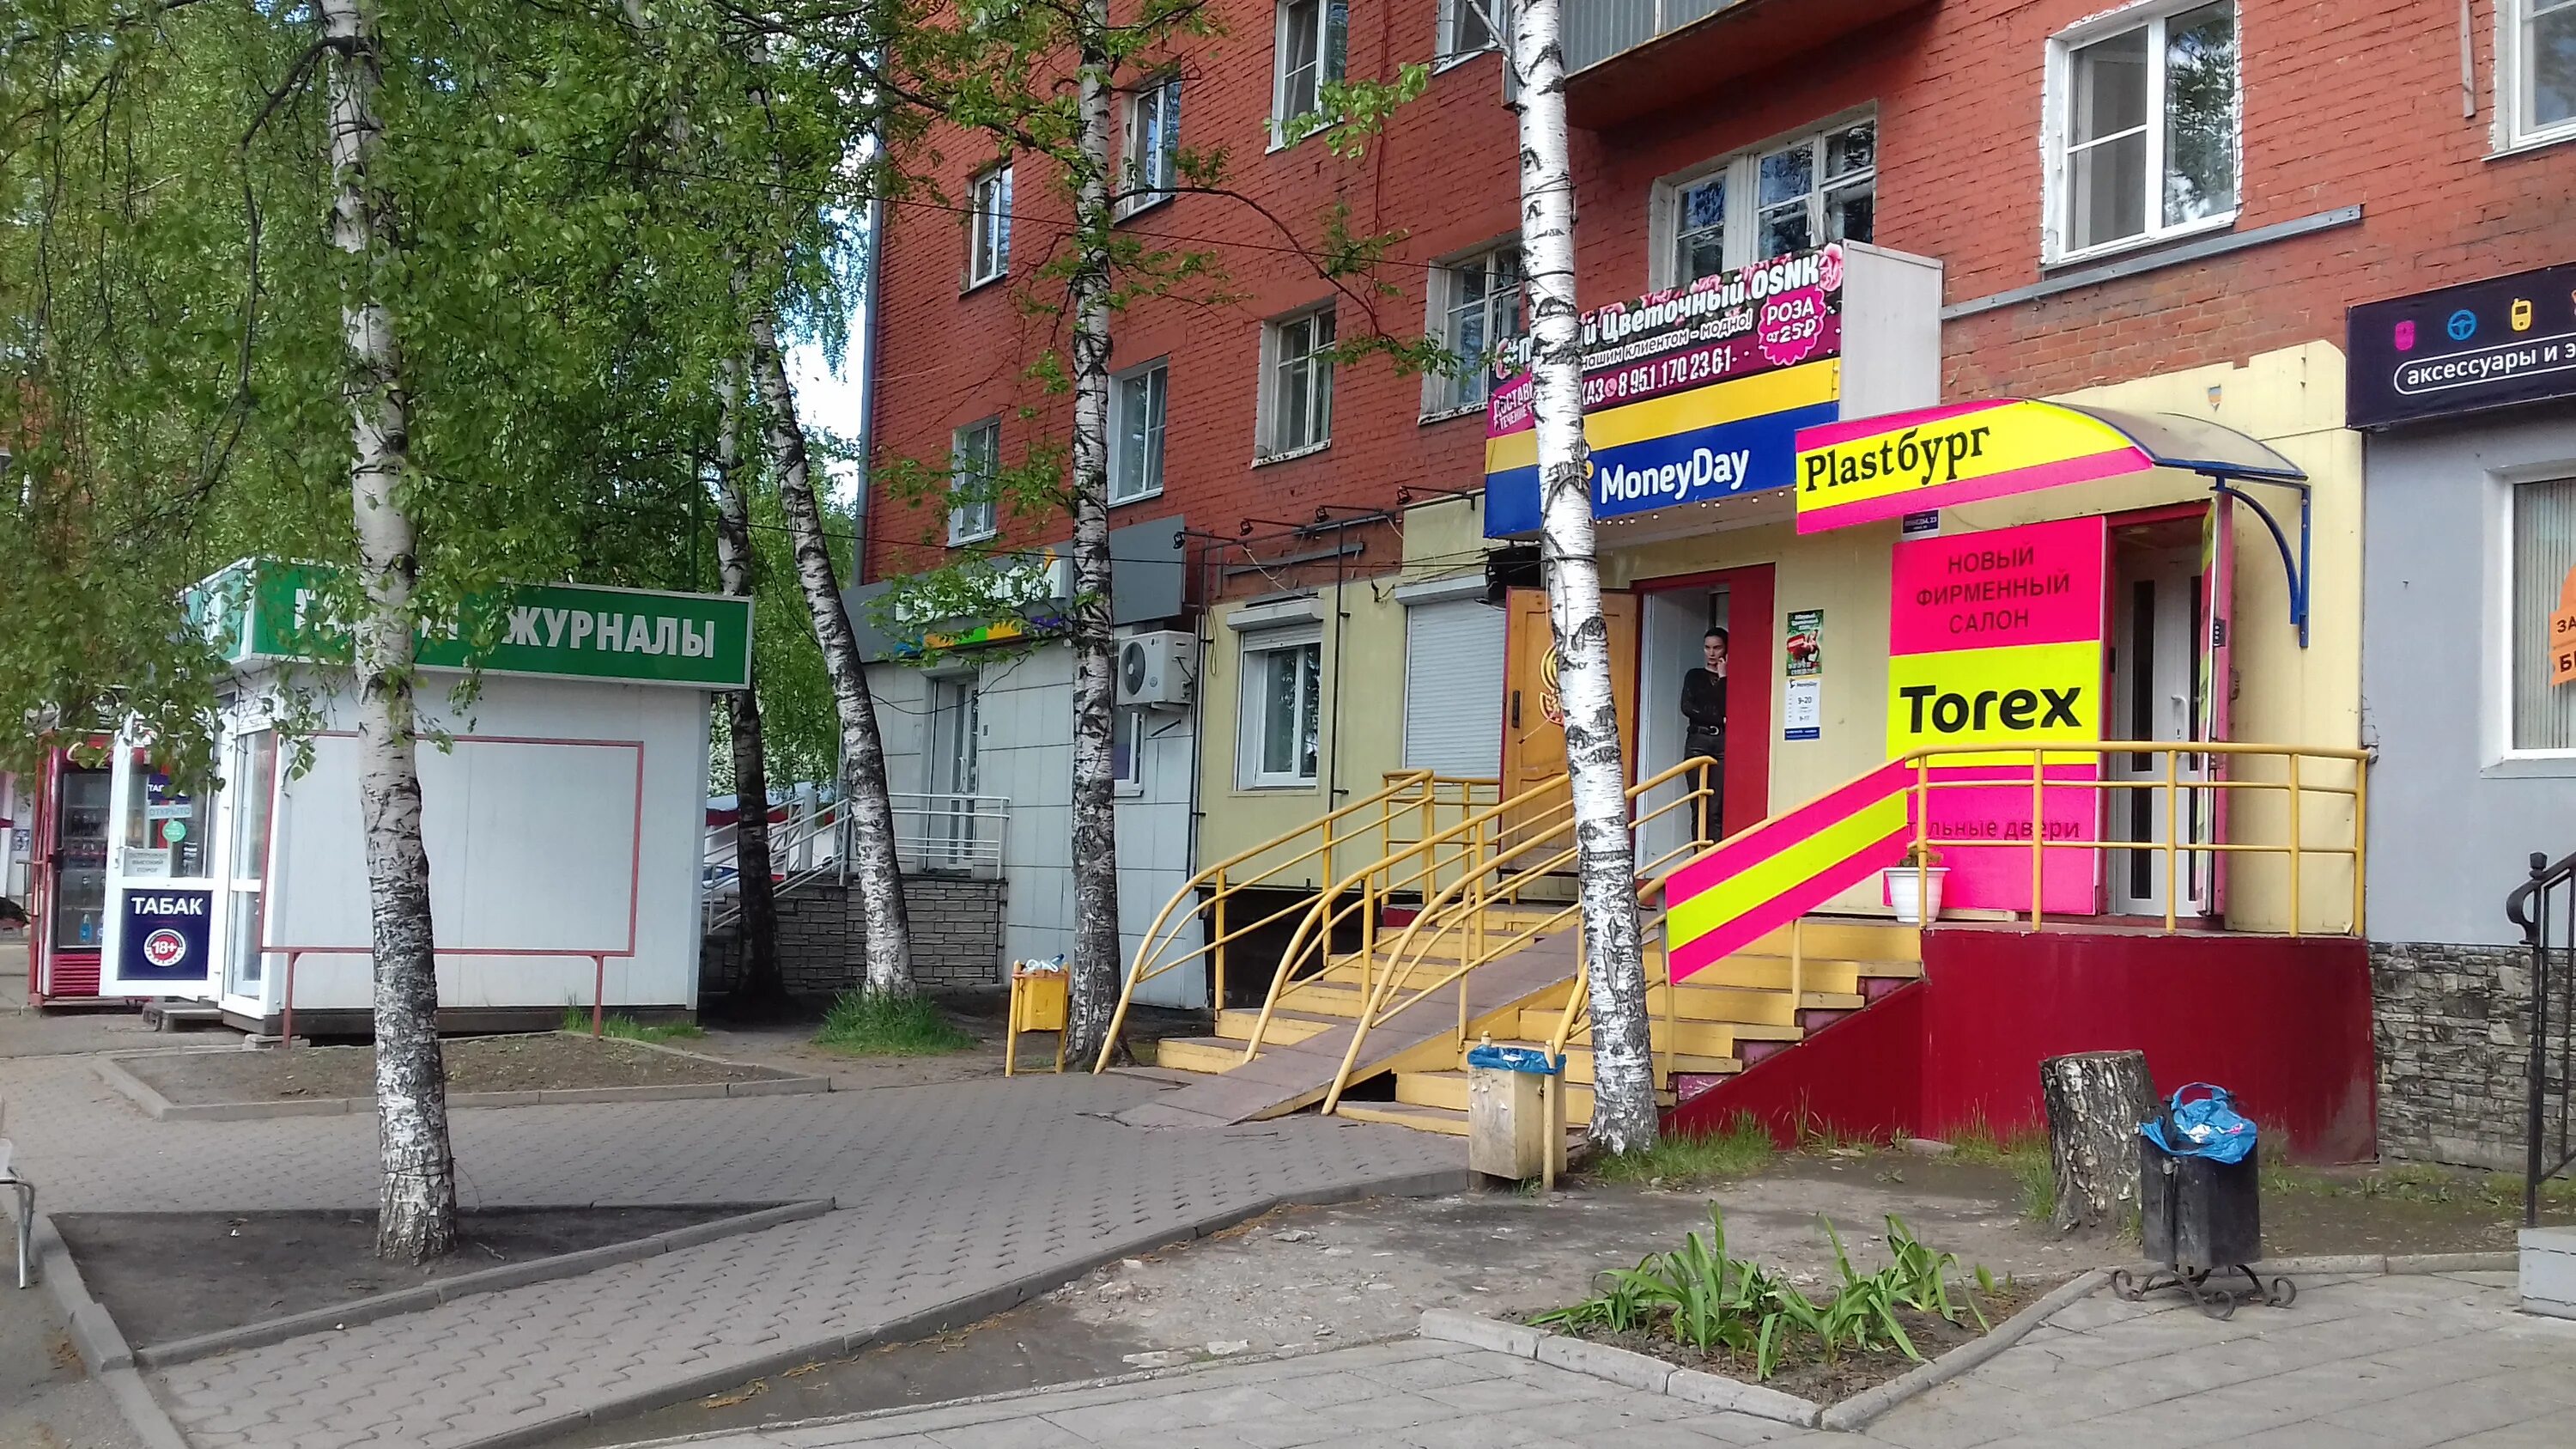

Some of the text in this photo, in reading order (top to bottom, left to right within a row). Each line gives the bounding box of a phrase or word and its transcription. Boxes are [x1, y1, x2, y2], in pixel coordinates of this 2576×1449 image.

[1602, 277, 1745, 344] Цветочный
[1751, 254, 1819, 300] OSNK
[1766, 300, 1814, 326] РОЗА
[1625, 328, 1688, 362] клиентом
[1699, 309, 1753, 342] модно!
[1619, 372, 1628, 397] 8
[1690, 350, 1710, 379] 23
[1712, 345, 1732, 374] 61
[2407, 349, 2536, 386] аксессуары
[2543, 344, 2558, 362] и
[1601, 447, 1750, 504] MoneyDay
[1805, 426, 1990, 492] Plastбург
[1947, 541, 2034, 574] НОВЫЙ
[1917, 569, 2070, 606] ФИРМЕННЫЙ
[501, 606, 715, 659] ЖУРНАЛЫ
[1949, 608, 2030, 634] САЛОН
[2559, 648, 2576, 673] Б
[1899, 685, 2082, 734] Torex
[131, 897, 204, 916] ТАБАК
[151, 941, 178, 954] 18+
